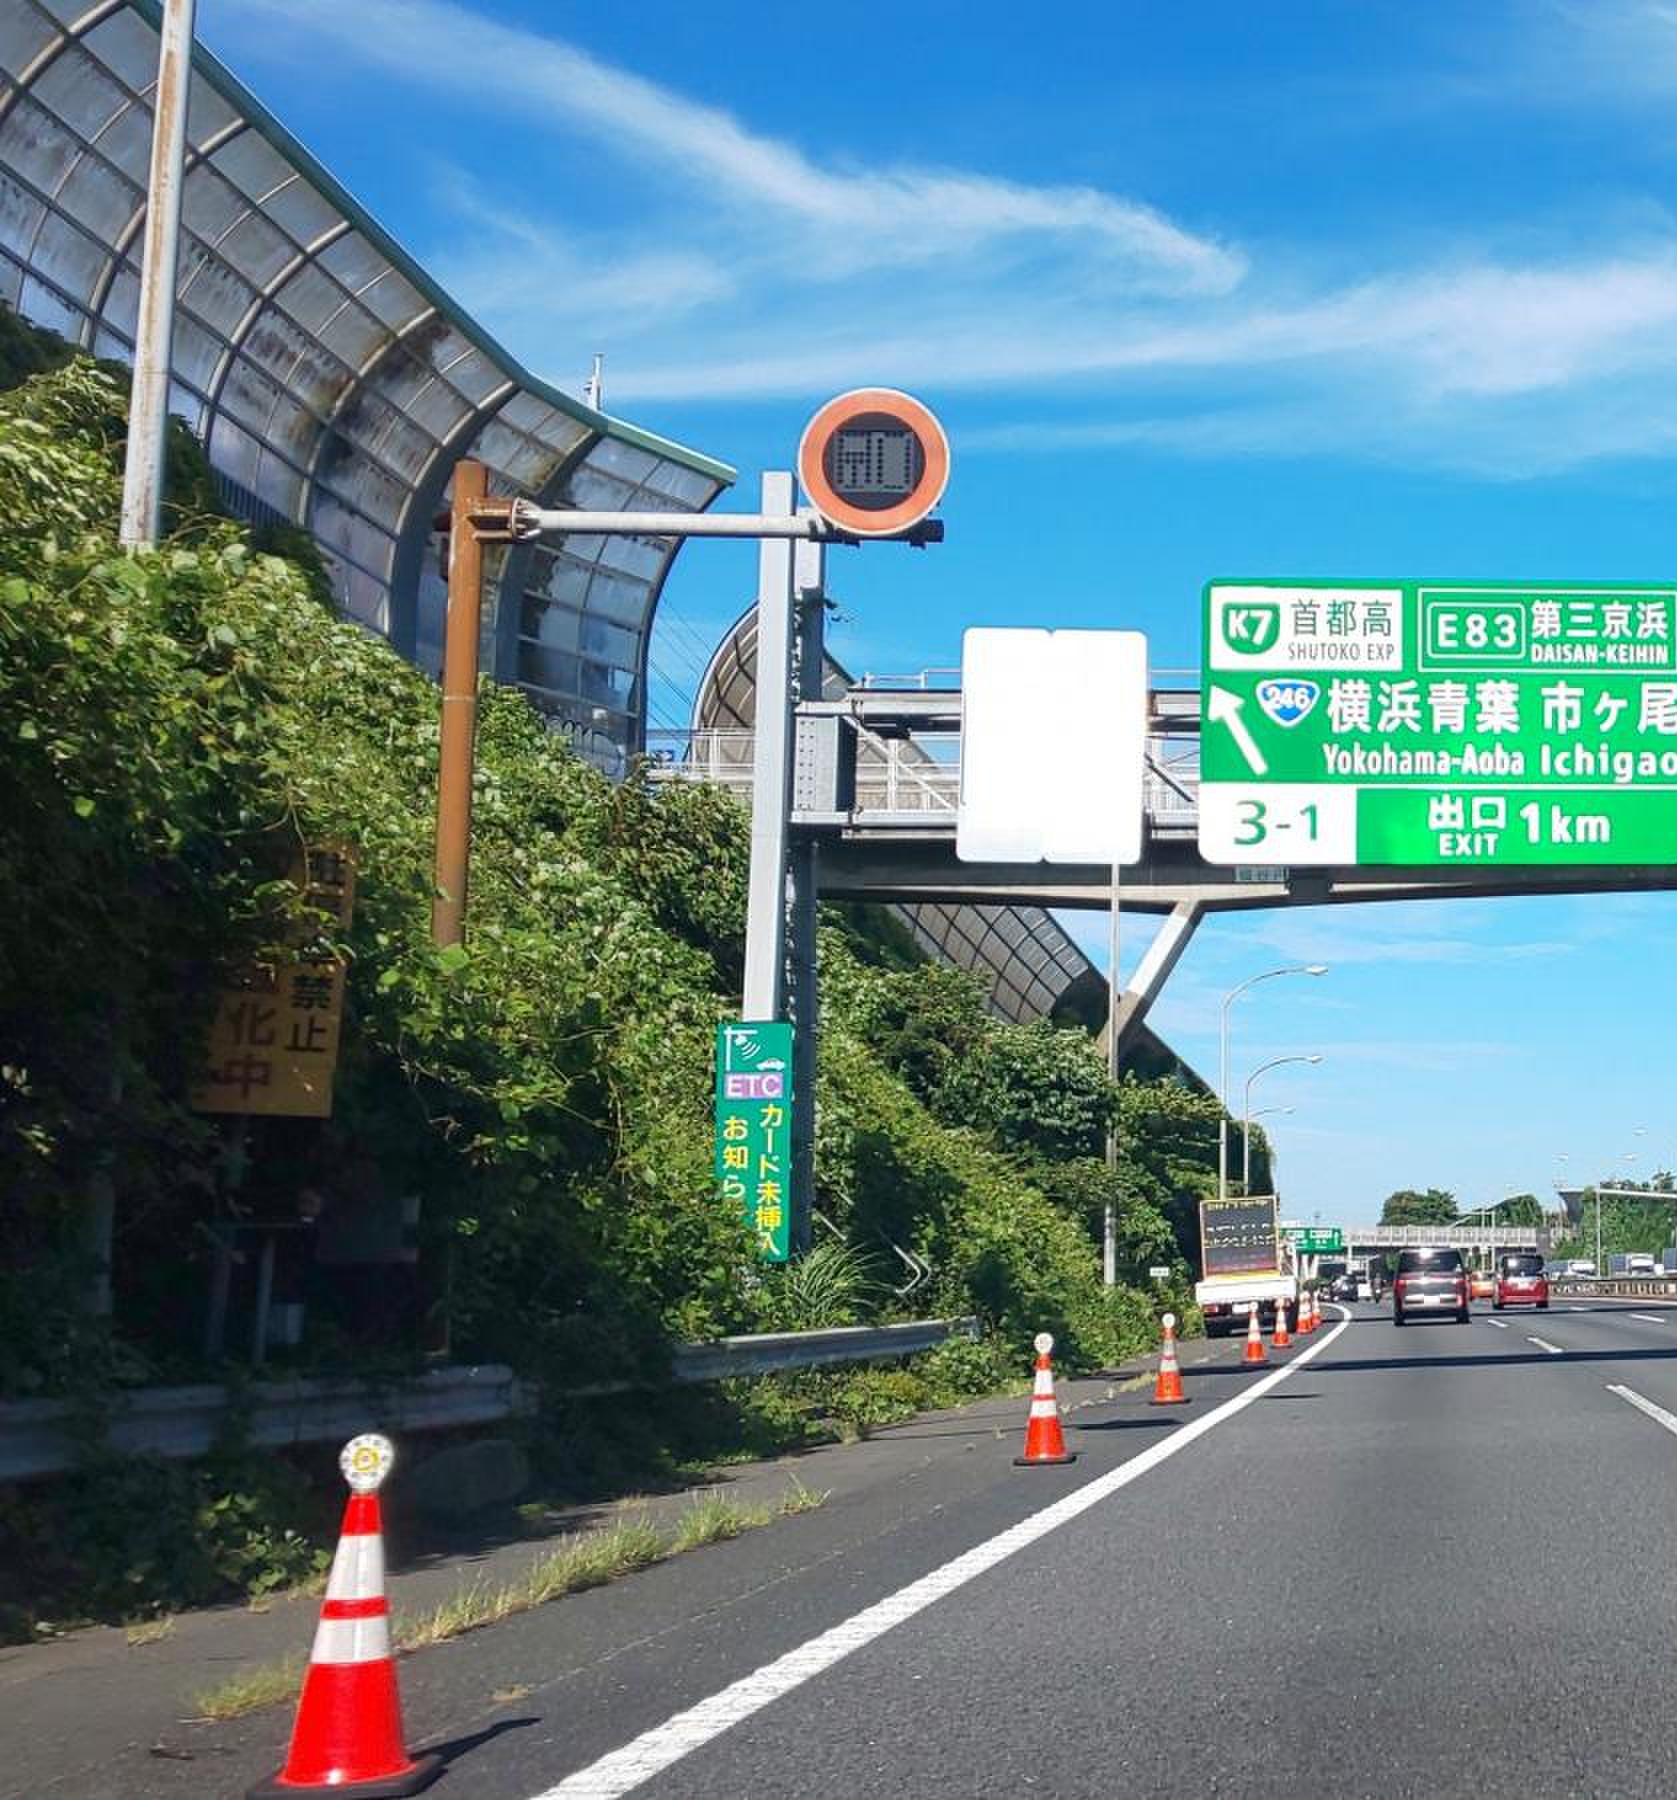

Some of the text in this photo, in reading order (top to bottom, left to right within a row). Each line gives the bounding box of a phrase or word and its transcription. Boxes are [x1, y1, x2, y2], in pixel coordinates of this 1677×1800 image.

[1228, 609, 1273, 646] K7
[1290, 598, 1393, 637] 首都高
[1437, 613, 1517, 648] E83
[1530, 599, 1668, 640] 第三京浜
[1287, 642, 1395, 661] SHUTOKO EXP
[1530, 643, 1669, 664] DAISAN-KEIHIN
[1266, 685, 1313, 710] 246
[1325, 678, 1521, 735] 横浜青葉
[1322, 741, 1525, 776] Yokohama-Aoba
[1232, 799, 1319, 846] 3-1
[1428, 793, 1507, 831] 出口
[1439, 833, 1499, 857] EXIT
[727, 1075, 781, 1098] ETC
[723, 1116, 748, 1199] お知ら
[755, 1104, 783, 1256] カード未挿入
